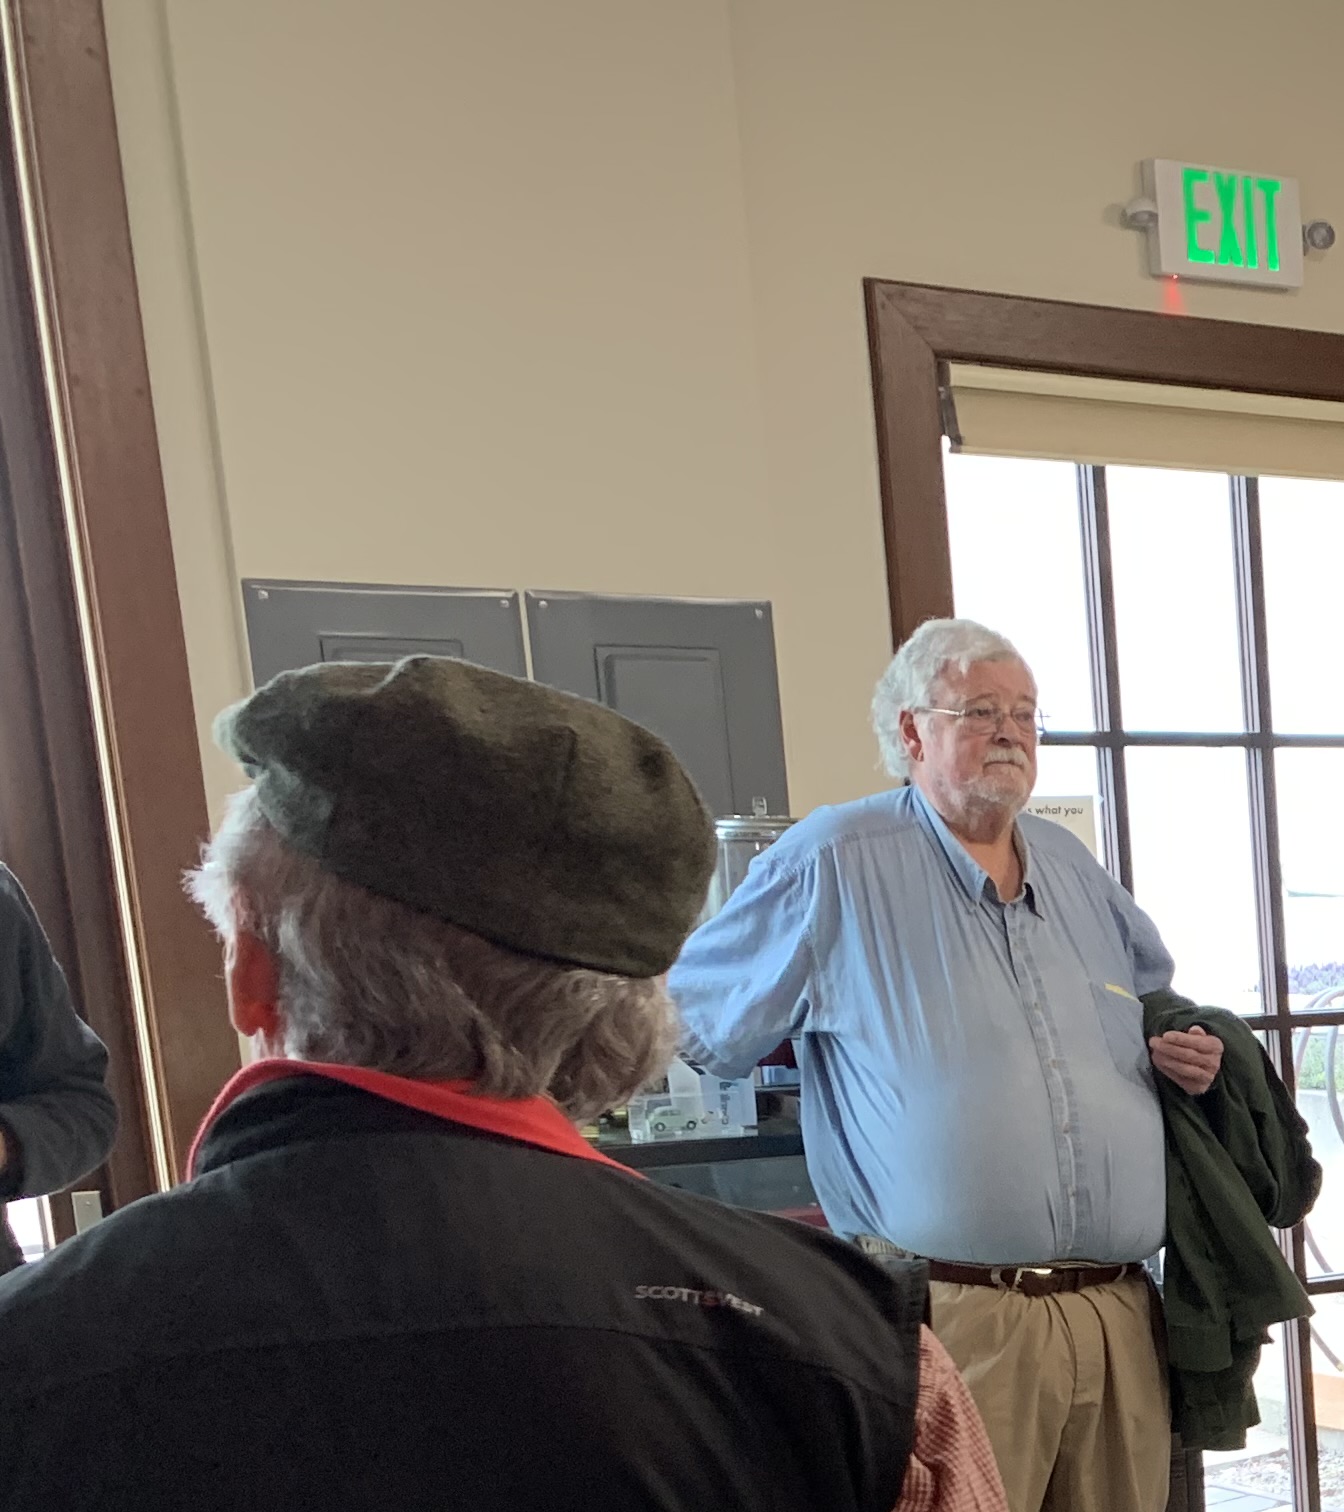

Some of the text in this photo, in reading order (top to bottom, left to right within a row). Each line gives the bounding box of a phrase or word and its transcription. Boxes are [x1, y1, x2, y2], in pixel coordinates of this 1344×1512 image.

[1182, 167, 1281, 271] EXIT
[1035, 804, 1061, 815] what
[1063, 806, 1084, 817] you
